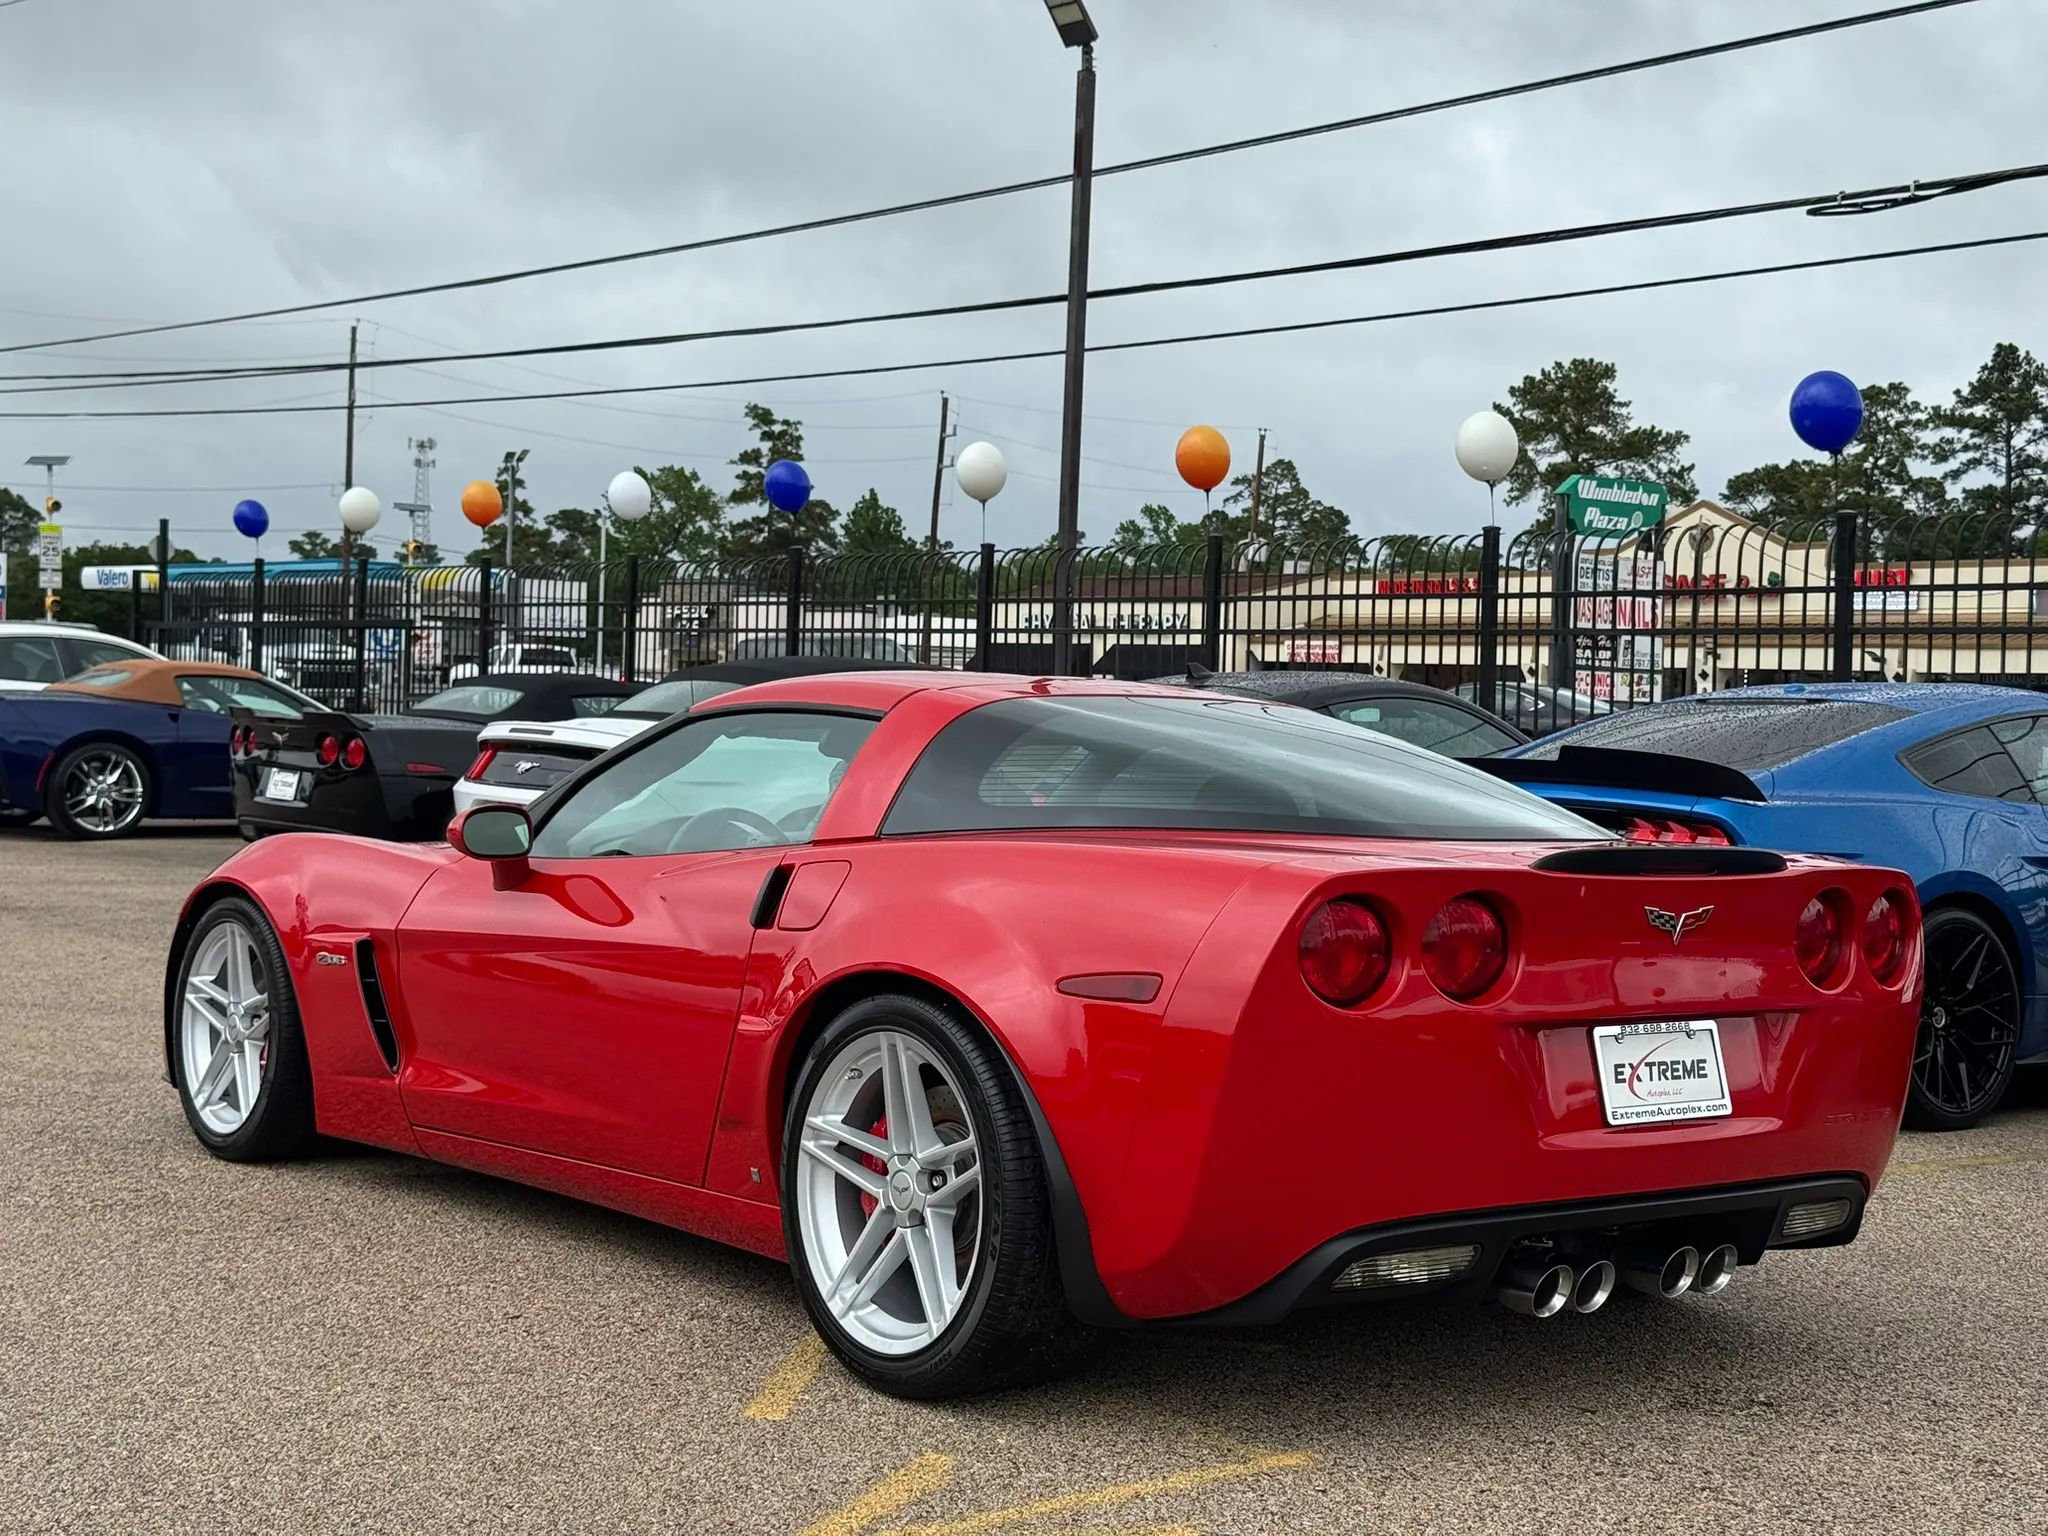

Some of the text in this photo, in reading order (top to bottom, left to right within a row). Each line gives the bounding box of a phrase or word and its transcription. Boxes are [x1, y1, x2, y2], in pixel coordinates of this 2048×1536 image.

[1578, 479, 1660, 507] Wimbledon
[1584, 506, 1629, 531] Plaza
[42, 545, 60, 558] 25
[97, 569, 129, 586] Valero
[1428, 580, 1459, 594] NALS
[1577, 599, 1613, 625] ASAGE
[1613, 1059, 1708, 1084] EXTREME
[1611, 1103, 1728, 1121] ExtremeAutoplex.com
